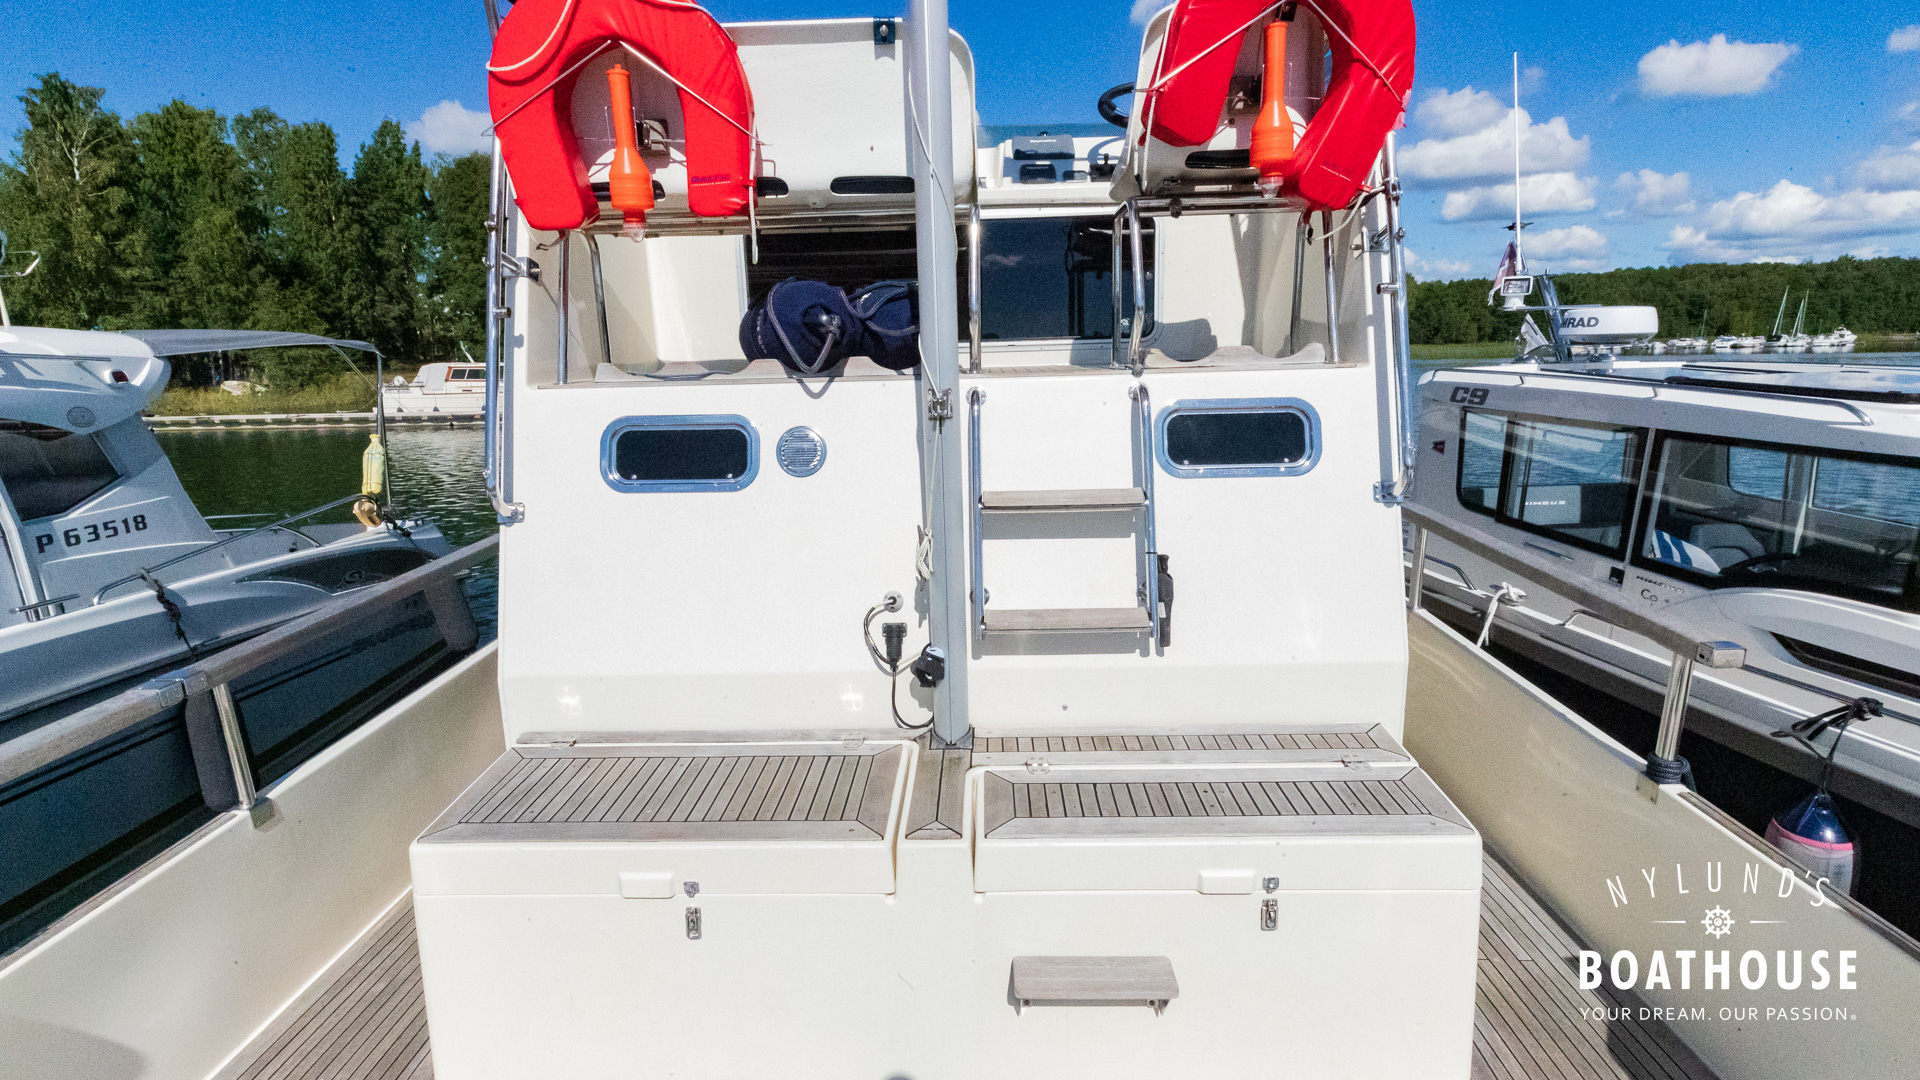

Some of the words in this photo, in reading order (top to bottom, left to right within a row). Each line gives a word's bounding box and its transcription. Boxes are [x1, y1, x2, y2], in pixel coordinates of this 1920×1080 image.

[1450, 386, 1489, 406] C9
[35, 533, 54, 554] P
[63, 514, 148, 547] 63518
